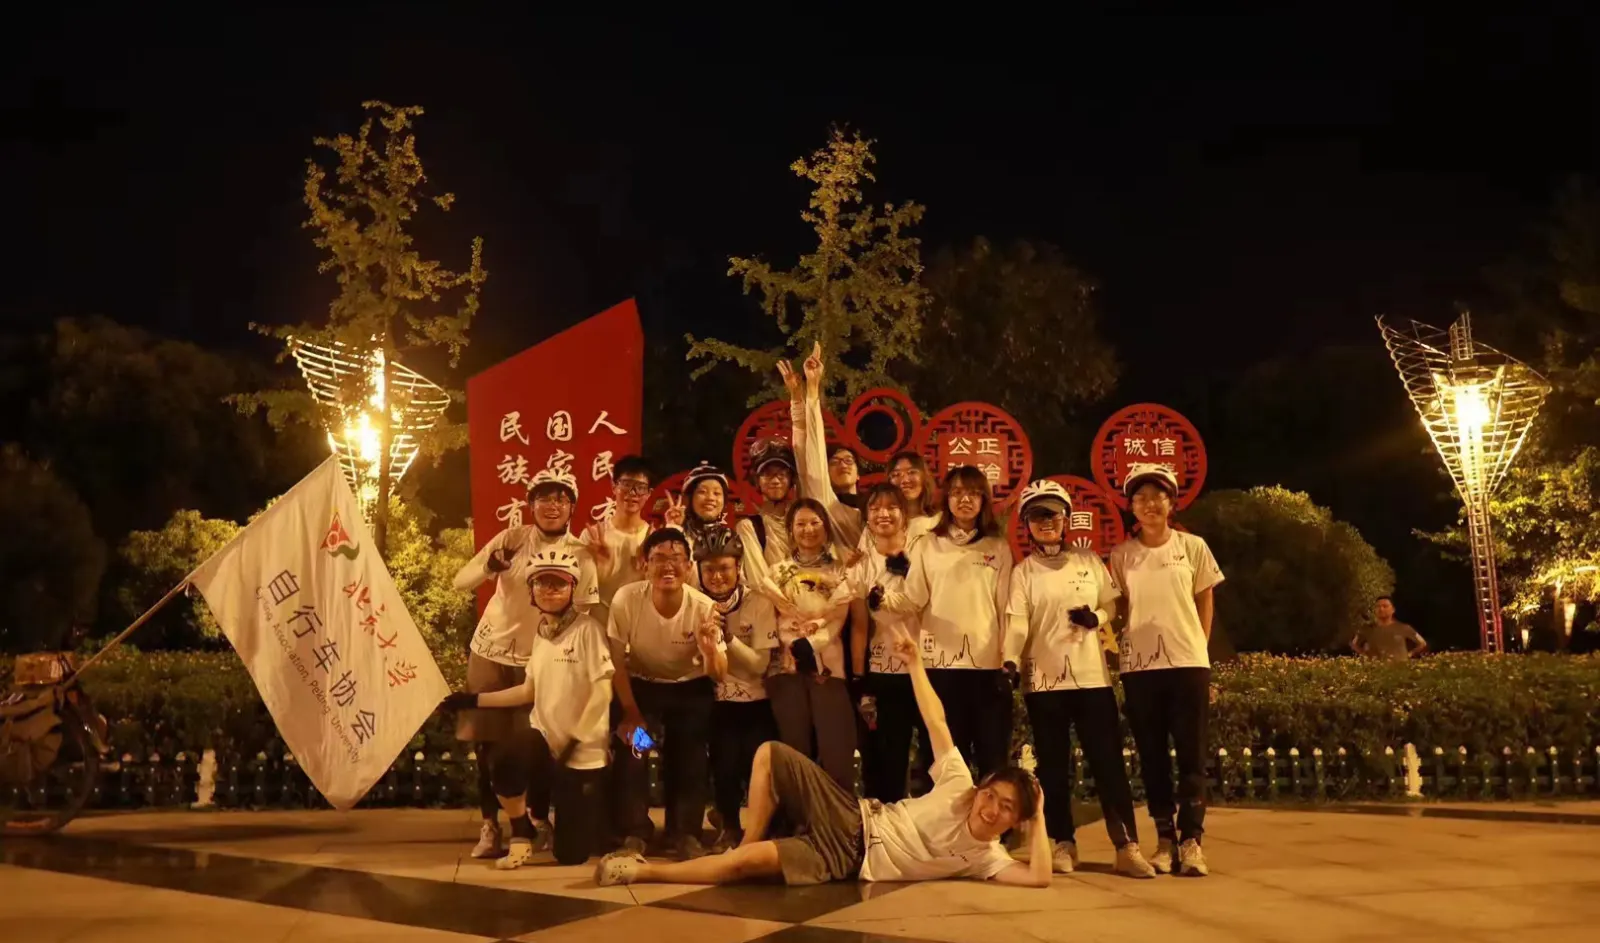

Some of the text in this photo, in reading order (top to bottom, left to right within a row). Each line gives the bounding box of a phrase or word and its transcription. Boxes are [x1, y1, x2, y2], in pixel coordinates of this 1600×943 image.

[948, 437, 1001, 455] 公正
[1124, 438, 1177, 457] 诚信
[267, 568, 378, 744] 自行车协会
[308, 679, 332, 715] Peking
[330, 716, 361, 766] University
